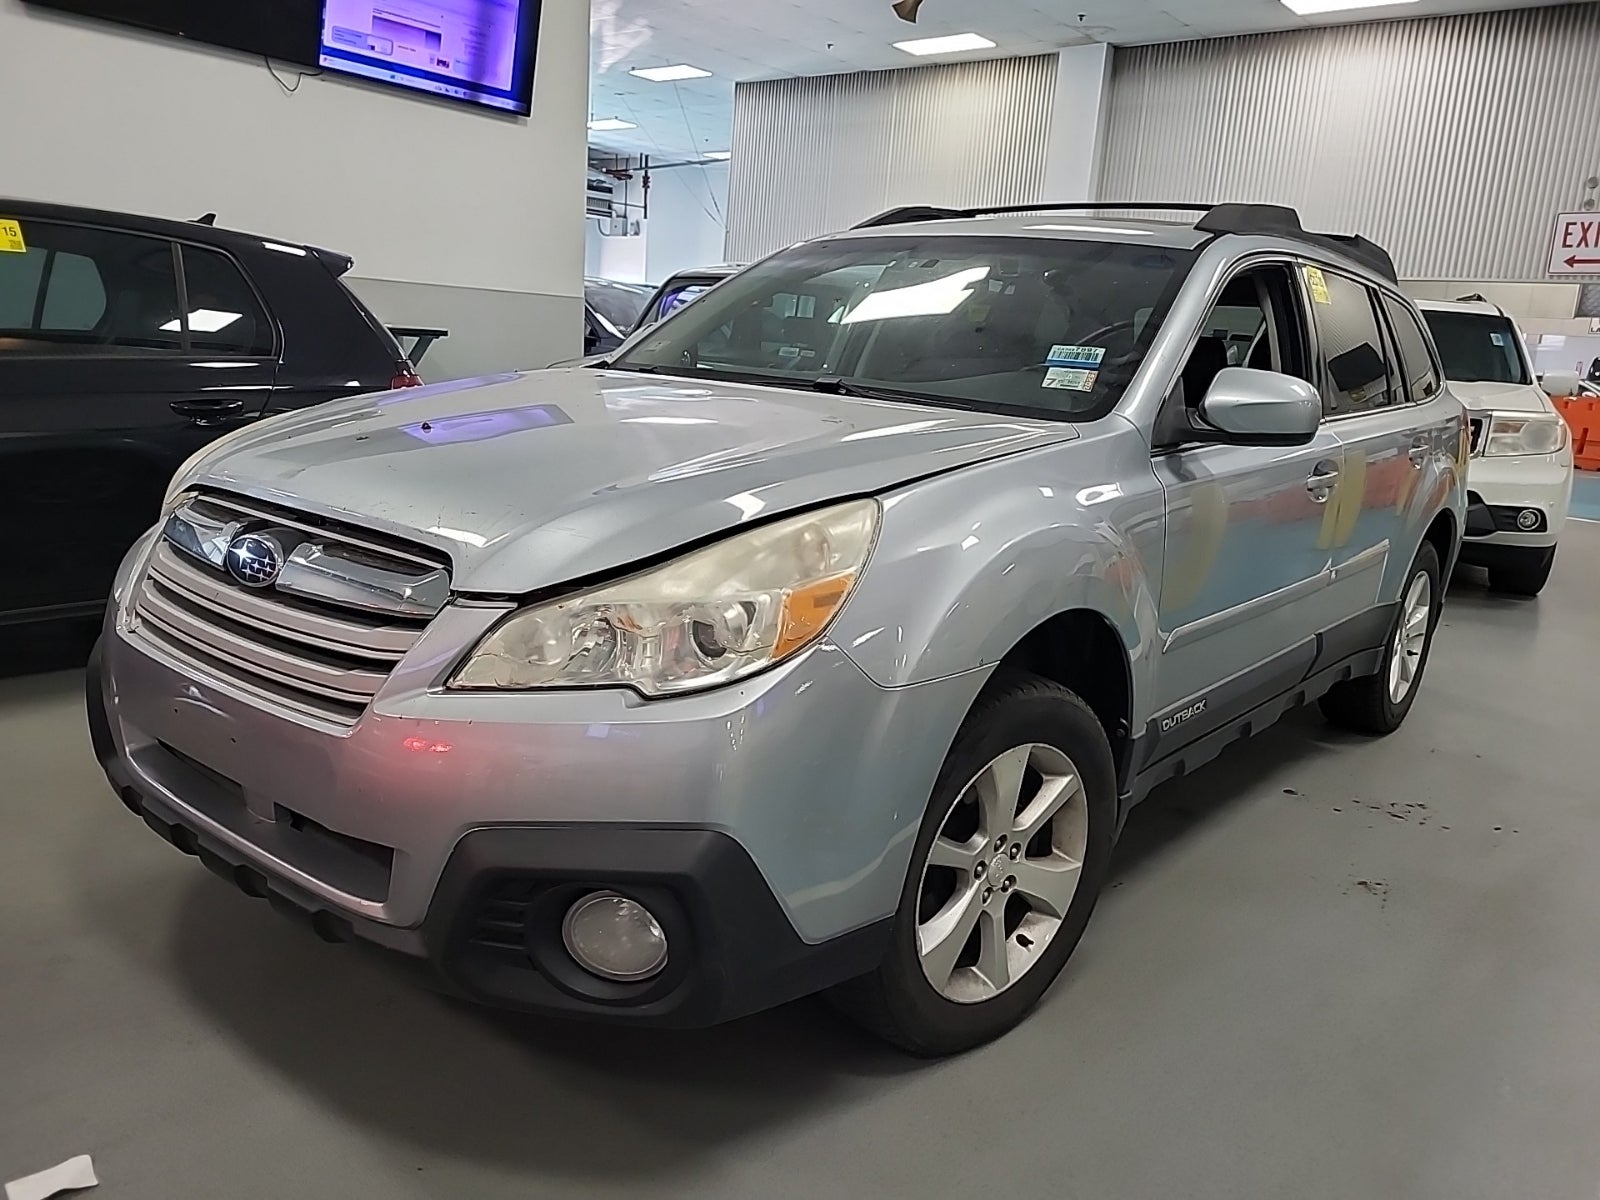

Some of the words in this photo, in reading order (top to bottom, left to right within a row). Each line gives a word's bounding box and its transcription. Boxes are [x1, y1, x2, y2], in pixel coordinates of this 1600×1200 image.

[2, 226, 17, 237] 15
[1046, 378, 1057, 386] 7
[1162, 699, 1206, 731] OUTBACK
